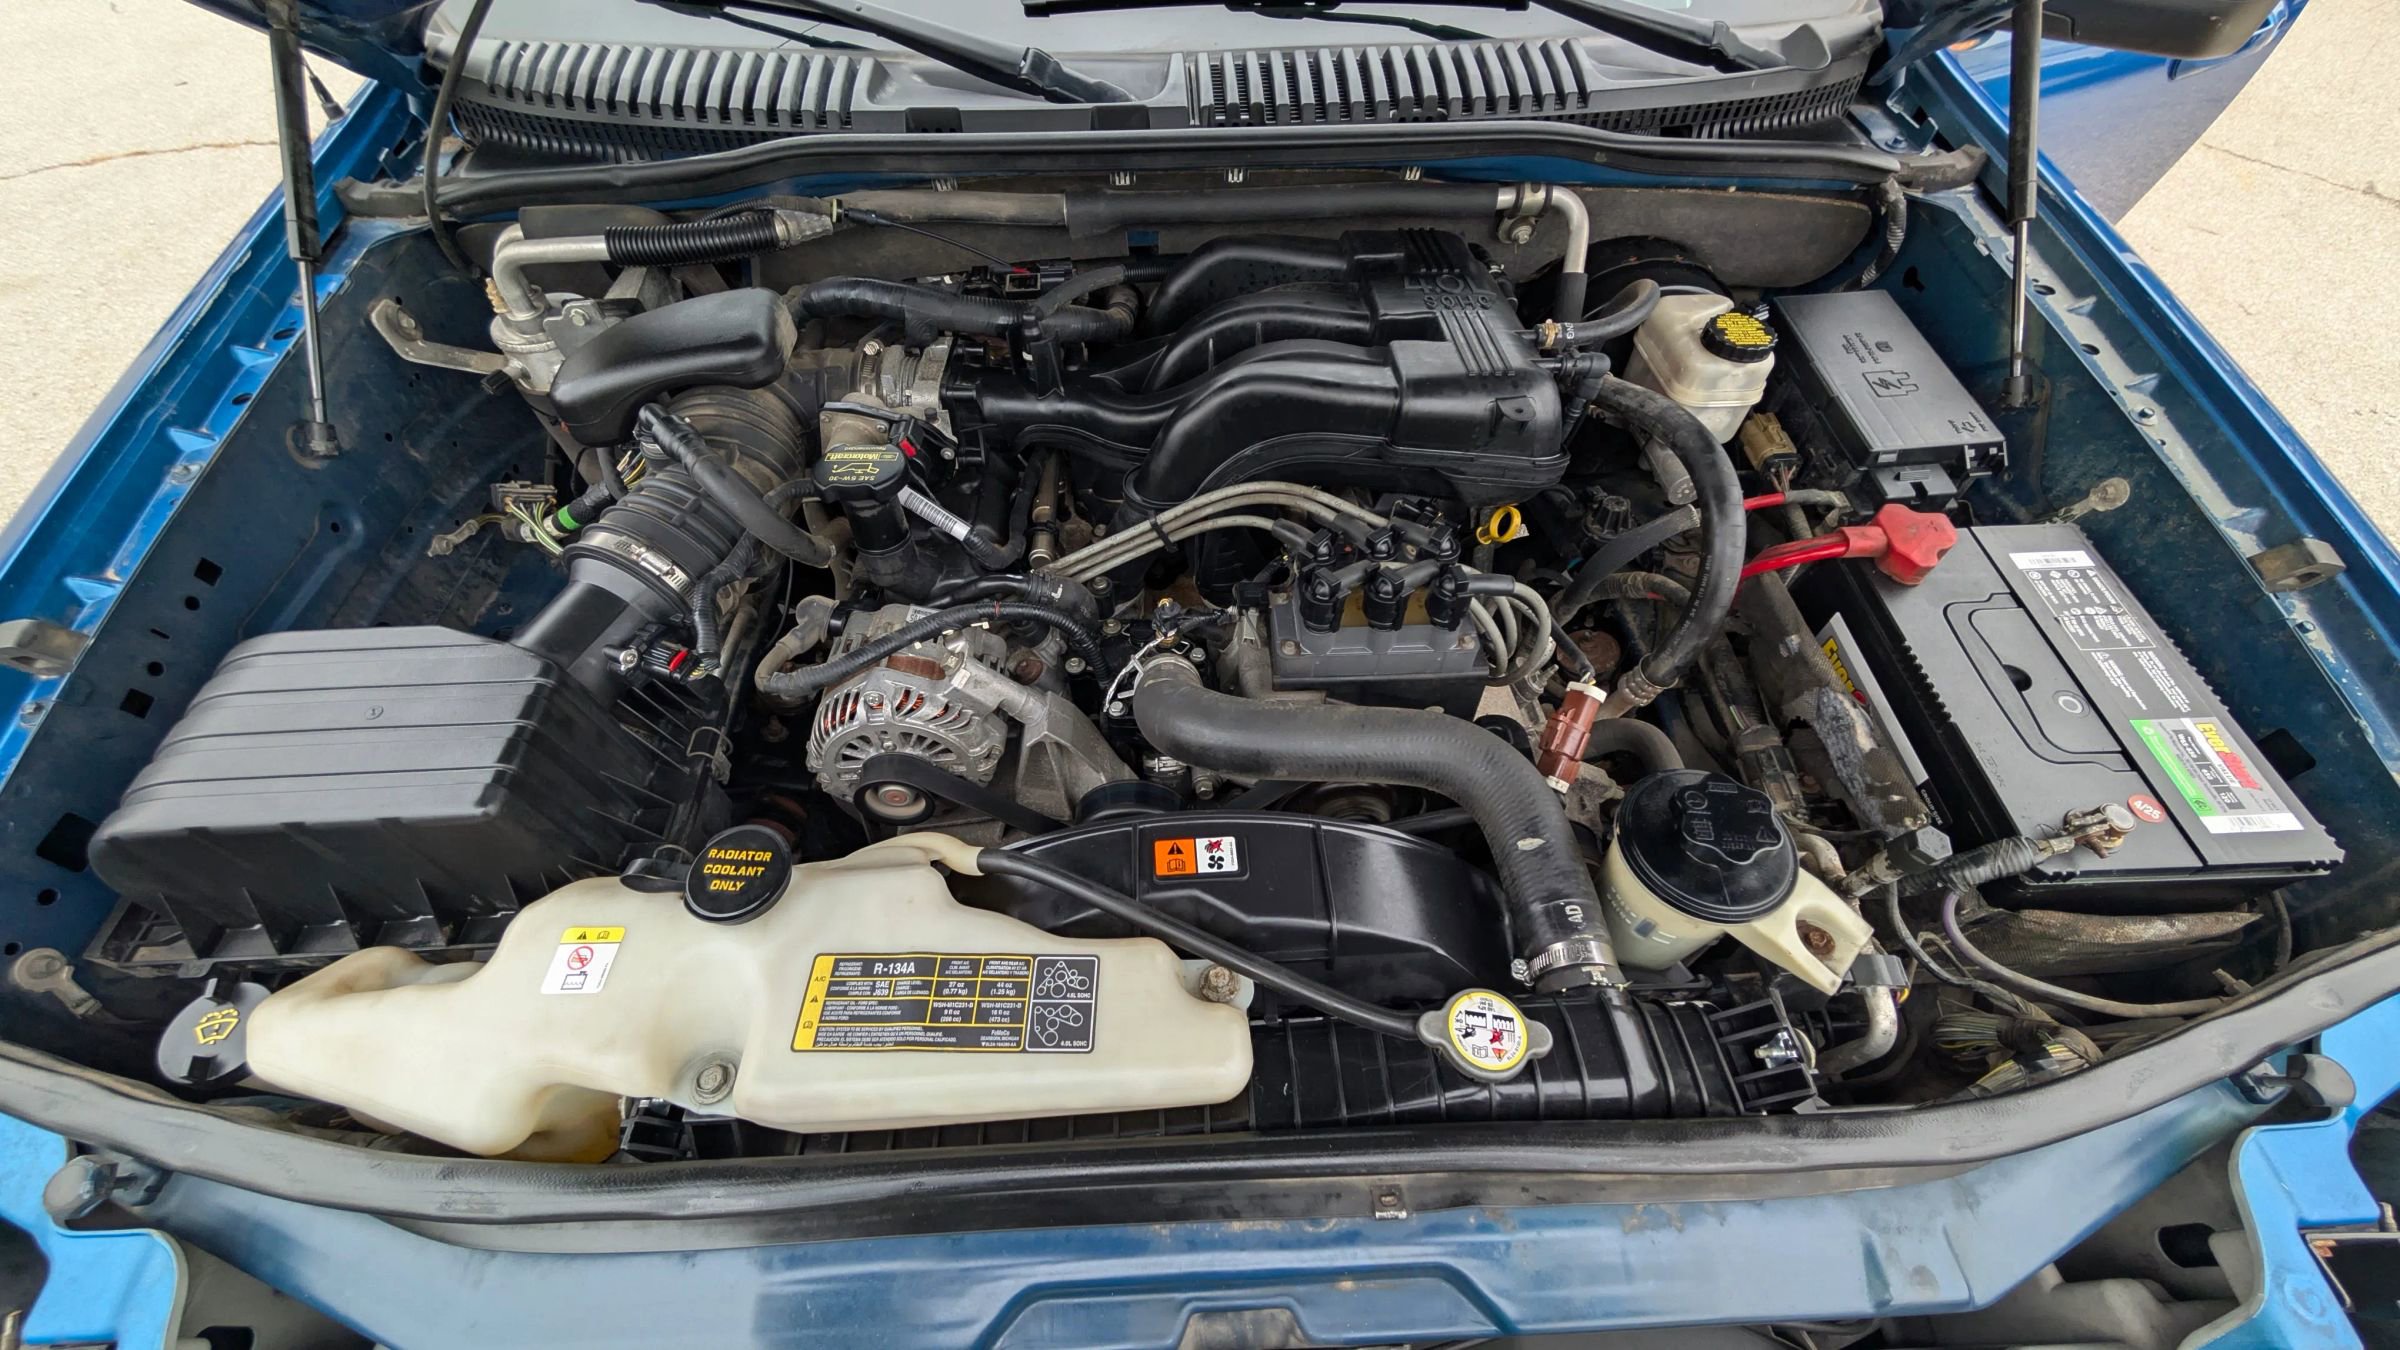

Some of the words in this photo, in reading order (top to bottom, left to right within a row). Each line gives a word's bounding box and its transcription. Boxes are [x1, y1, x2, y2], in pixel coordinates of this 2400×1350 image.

[1424, 296, 1491, 310] SOHC
[2133, 801, 2161, 819] 4/25
[708, 849, 772, 862] RADIATOR
[704, 864, 765, 877] COOLANT
[710, 880, 746, 891] ONLY
[873, 962, 915, 975] R-134A
